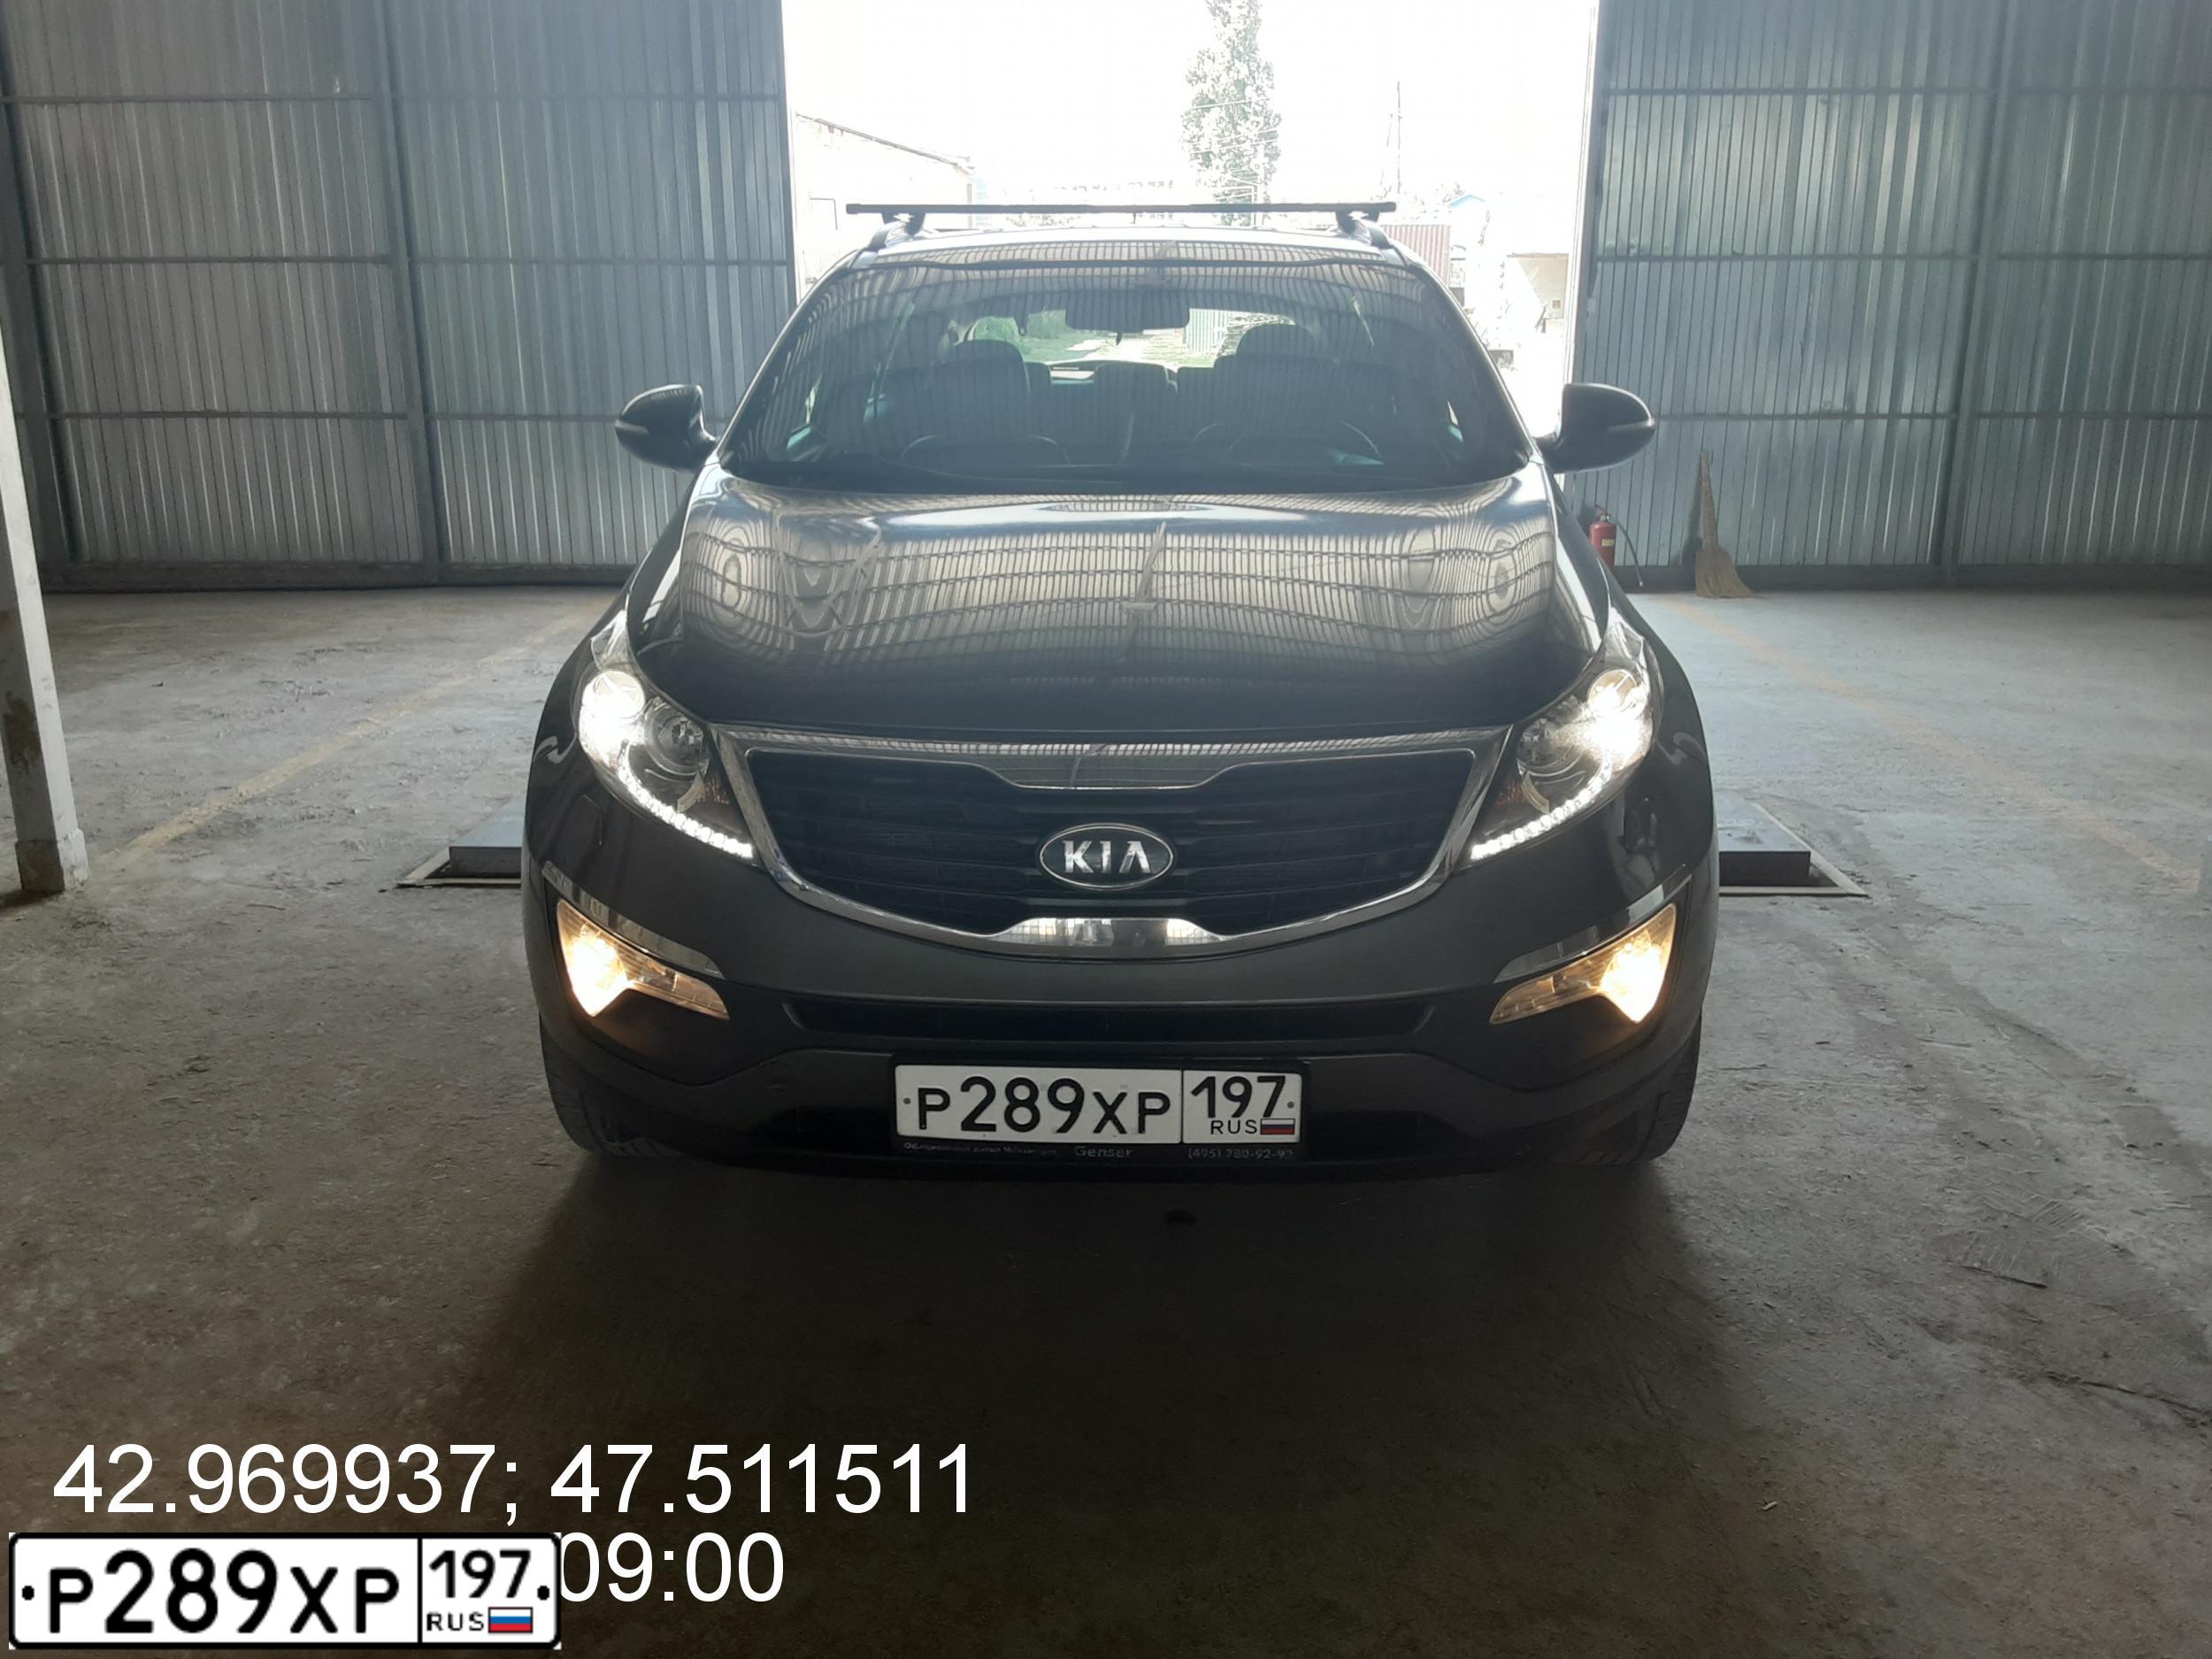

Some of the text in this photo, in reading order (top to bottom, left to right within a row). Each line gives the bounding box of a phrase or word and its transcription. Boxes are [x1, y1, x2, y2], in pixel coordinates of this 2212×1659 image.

[1063, 840, 1151, 873] KIA
[1190, 1075, 1286, 1118] 197
[1210, 1118, 1258, 1135] RUS
[1074, 1145, 1133, 1158] Genser
